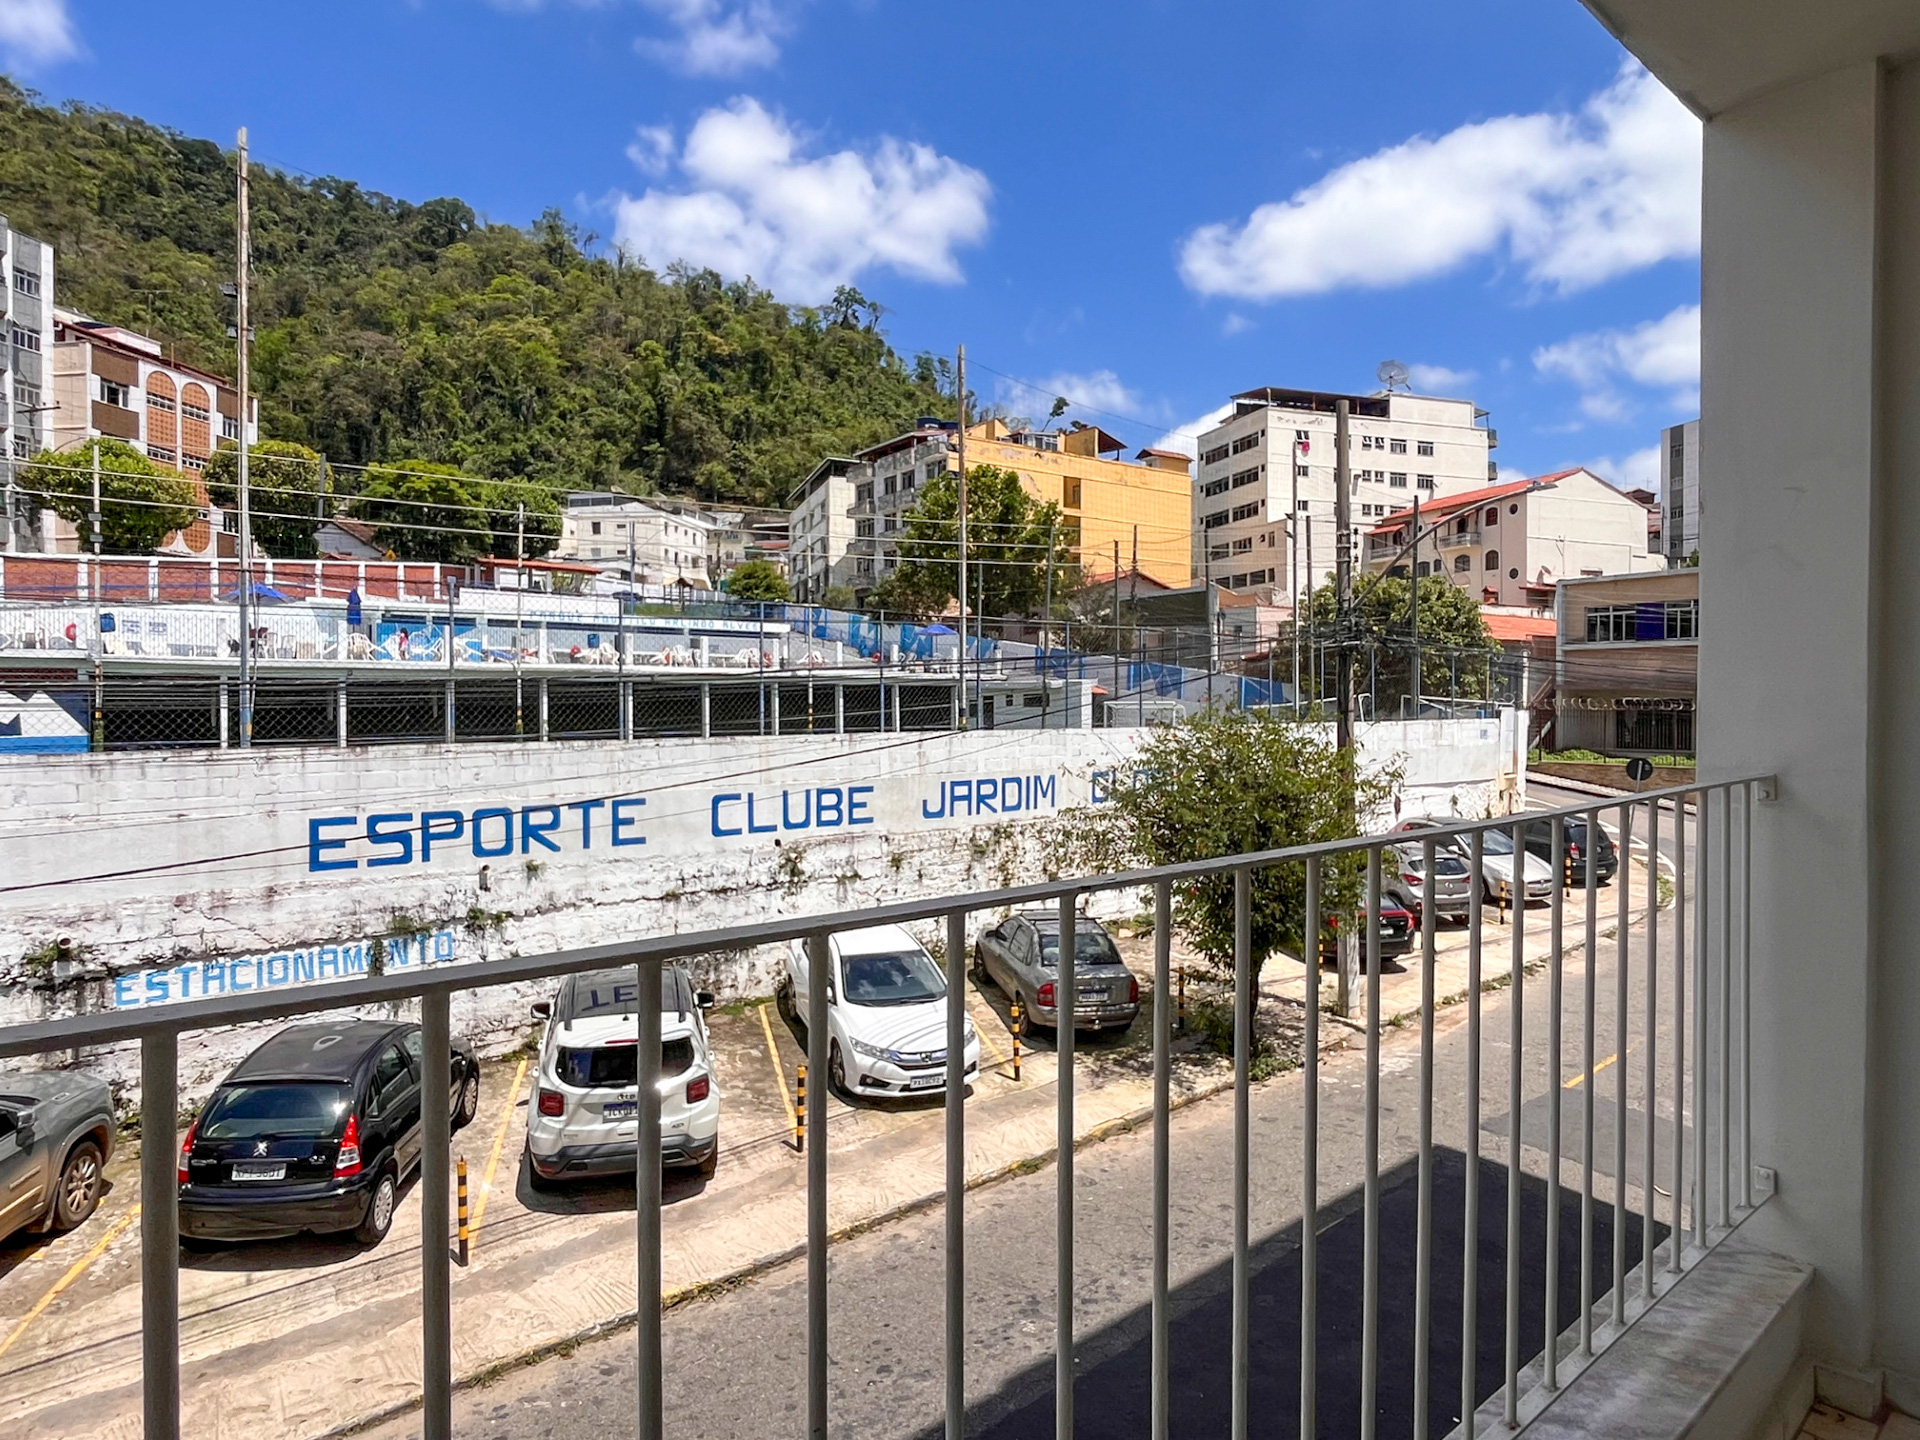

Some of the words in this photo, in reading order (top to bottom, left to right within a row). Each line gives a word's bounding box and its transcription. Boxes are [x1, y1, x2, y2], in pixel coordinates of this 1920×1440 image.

[309, 798, 646, 872] ESPORTE
[711, 786, 874, 837] CLUBE
[922, 774, 1056, 819] JARDIM
